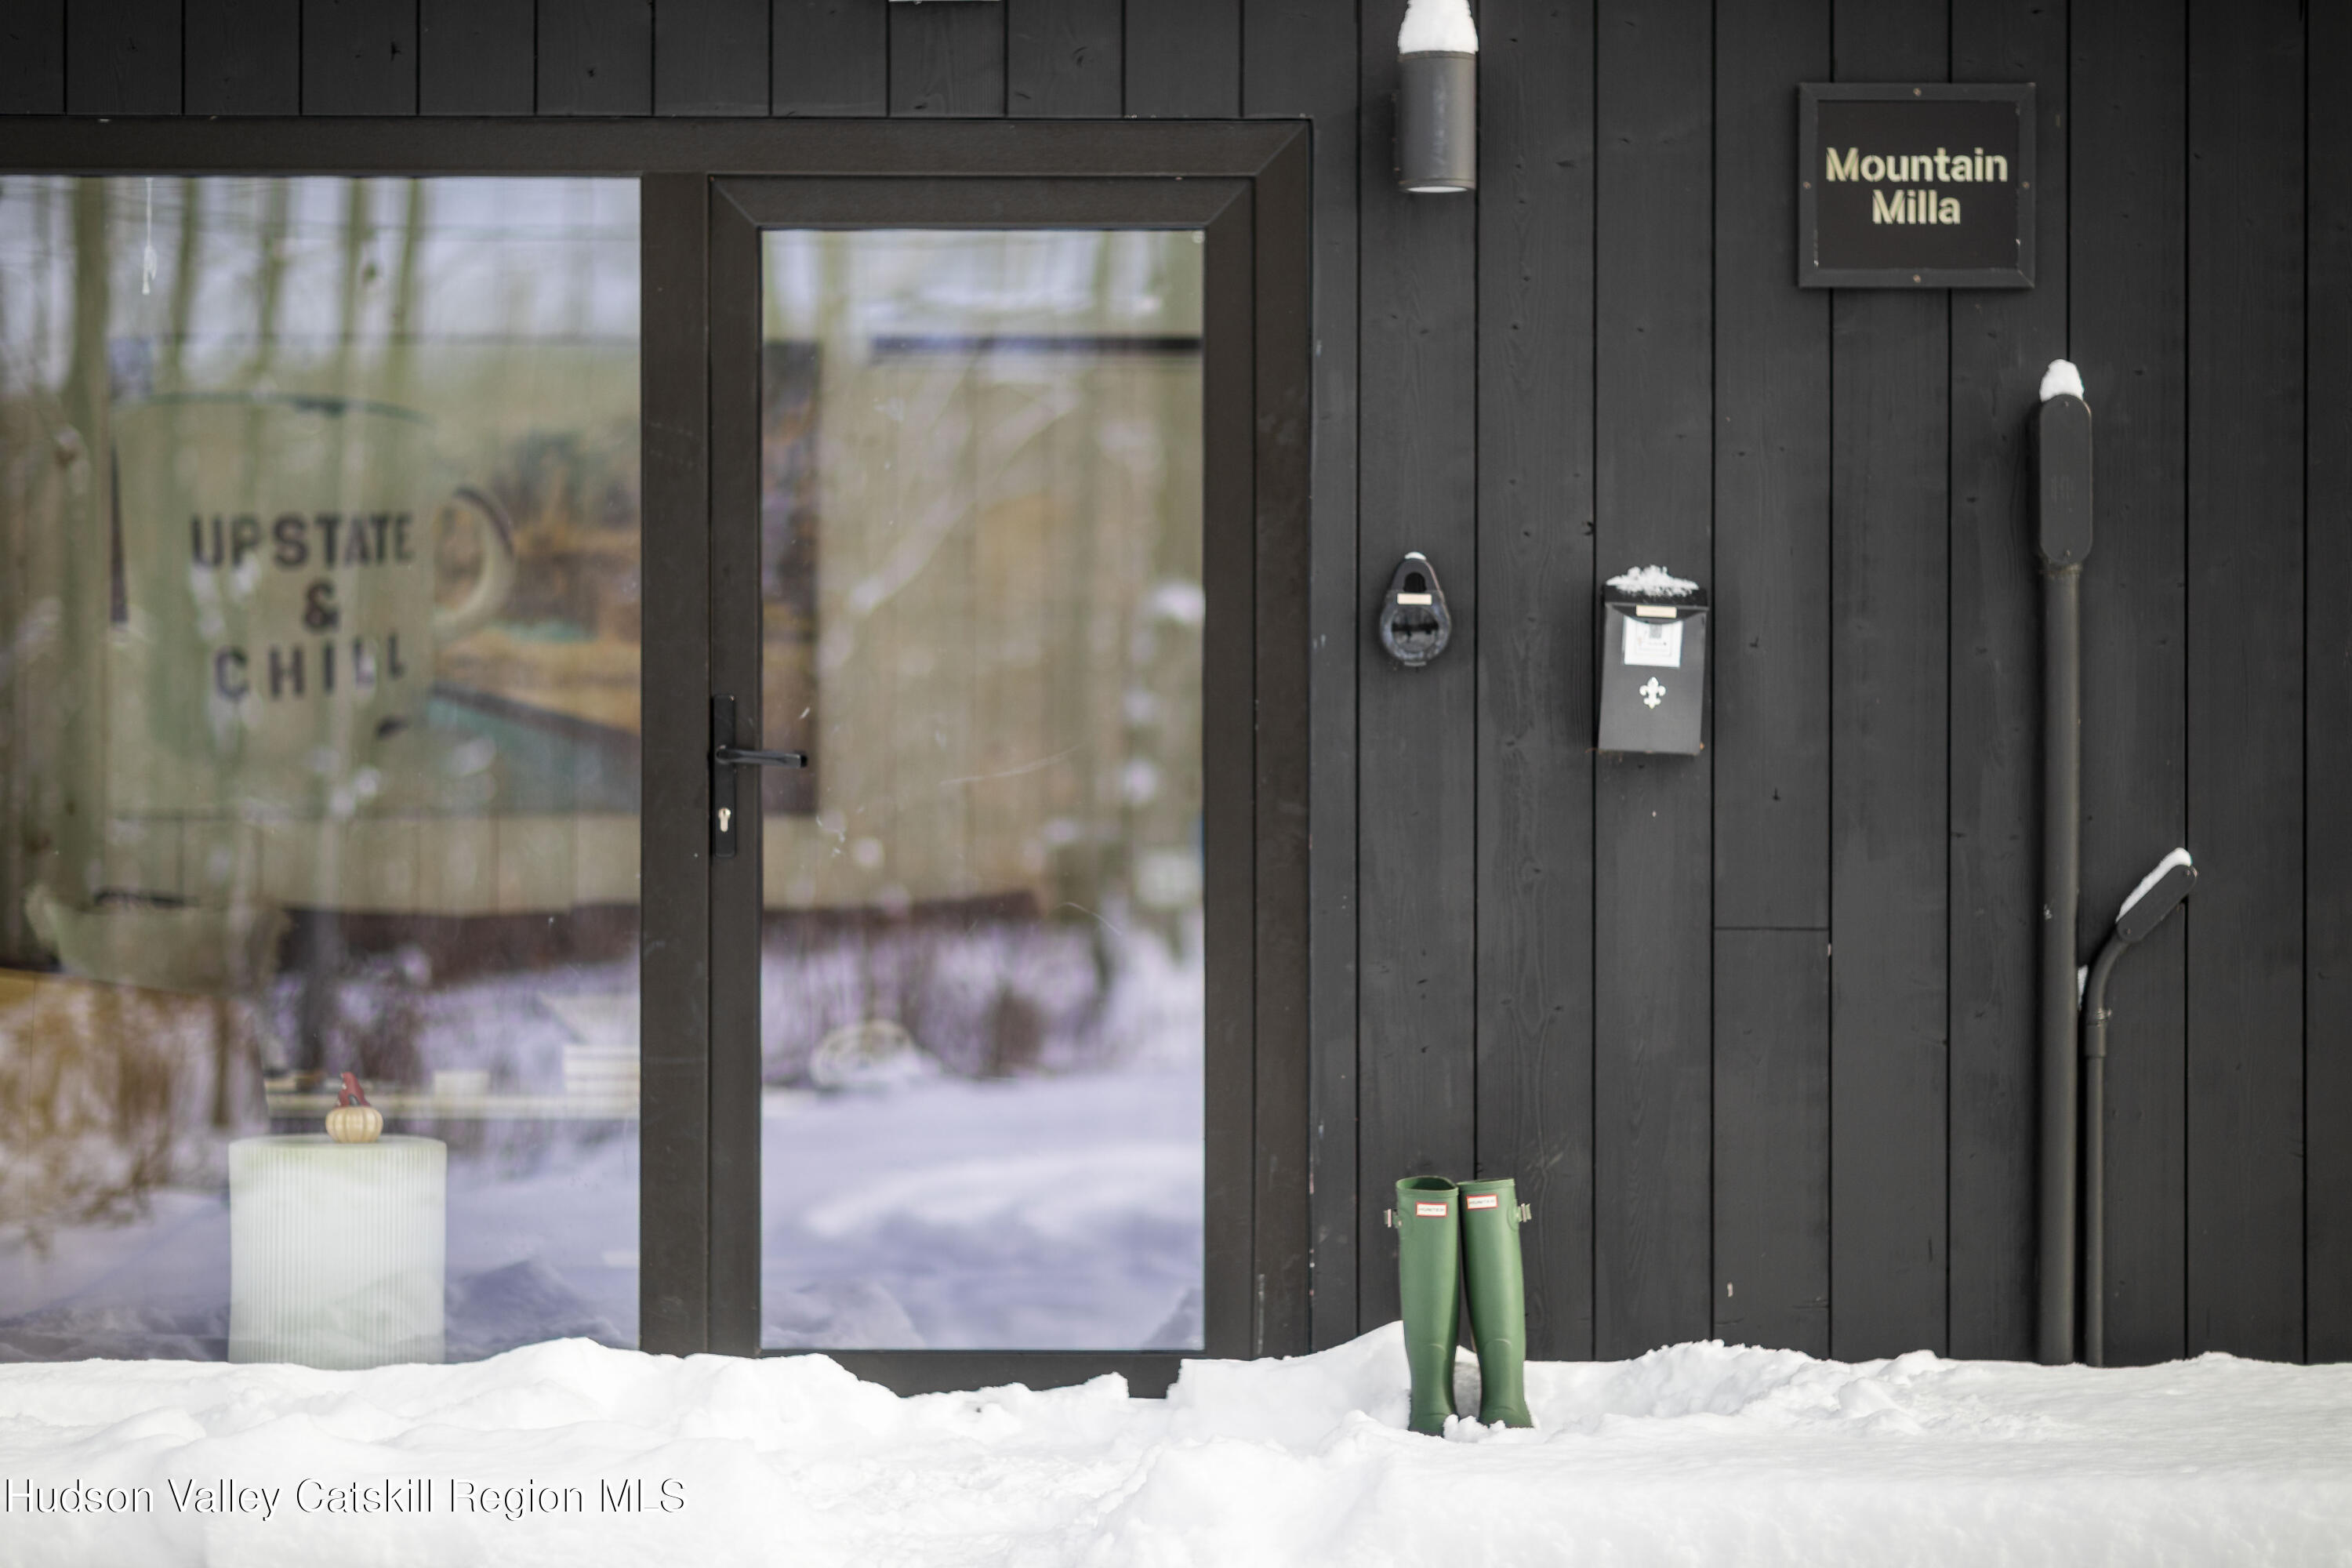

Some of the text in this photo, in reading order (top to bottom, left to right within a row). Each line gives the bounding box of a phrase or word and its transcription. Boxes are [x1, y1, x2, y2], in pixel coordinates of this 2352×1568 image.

[1825, 147, 2009, 183] Mountain
[1871, 189, 1962, 225] Milla
[190, 512, 414, 569] UPSTATE
[303, 578, 341, 633] &
[214, 633, 405, 701] CHILL
